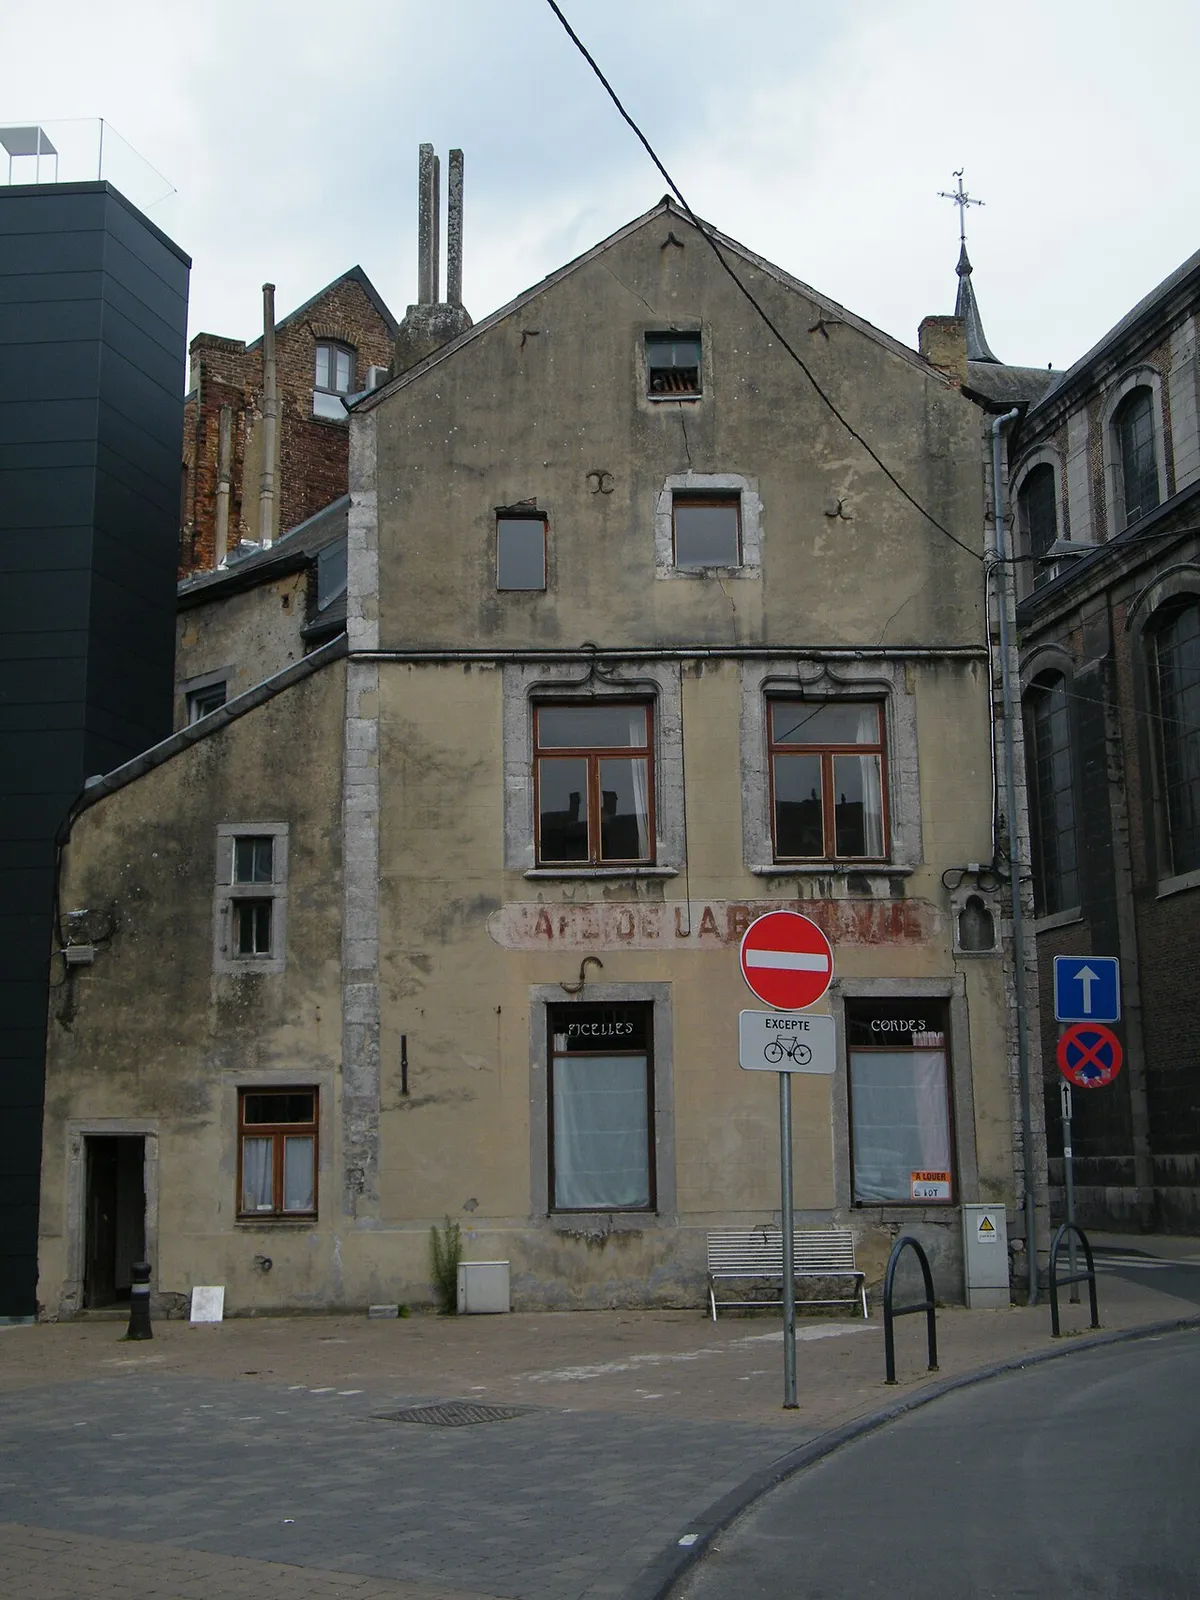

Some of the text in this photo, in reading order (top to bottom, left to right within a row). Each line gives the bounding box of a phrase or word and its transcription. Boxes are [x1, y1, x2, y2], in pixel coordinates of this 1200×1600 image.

[674, 905, 721, 939] LA
[765, 1018, 810, 1031] EXCEPTE
[871, 1019, 926, 1032] CORDES
[922, 1172, 946, 1181] LOUER
